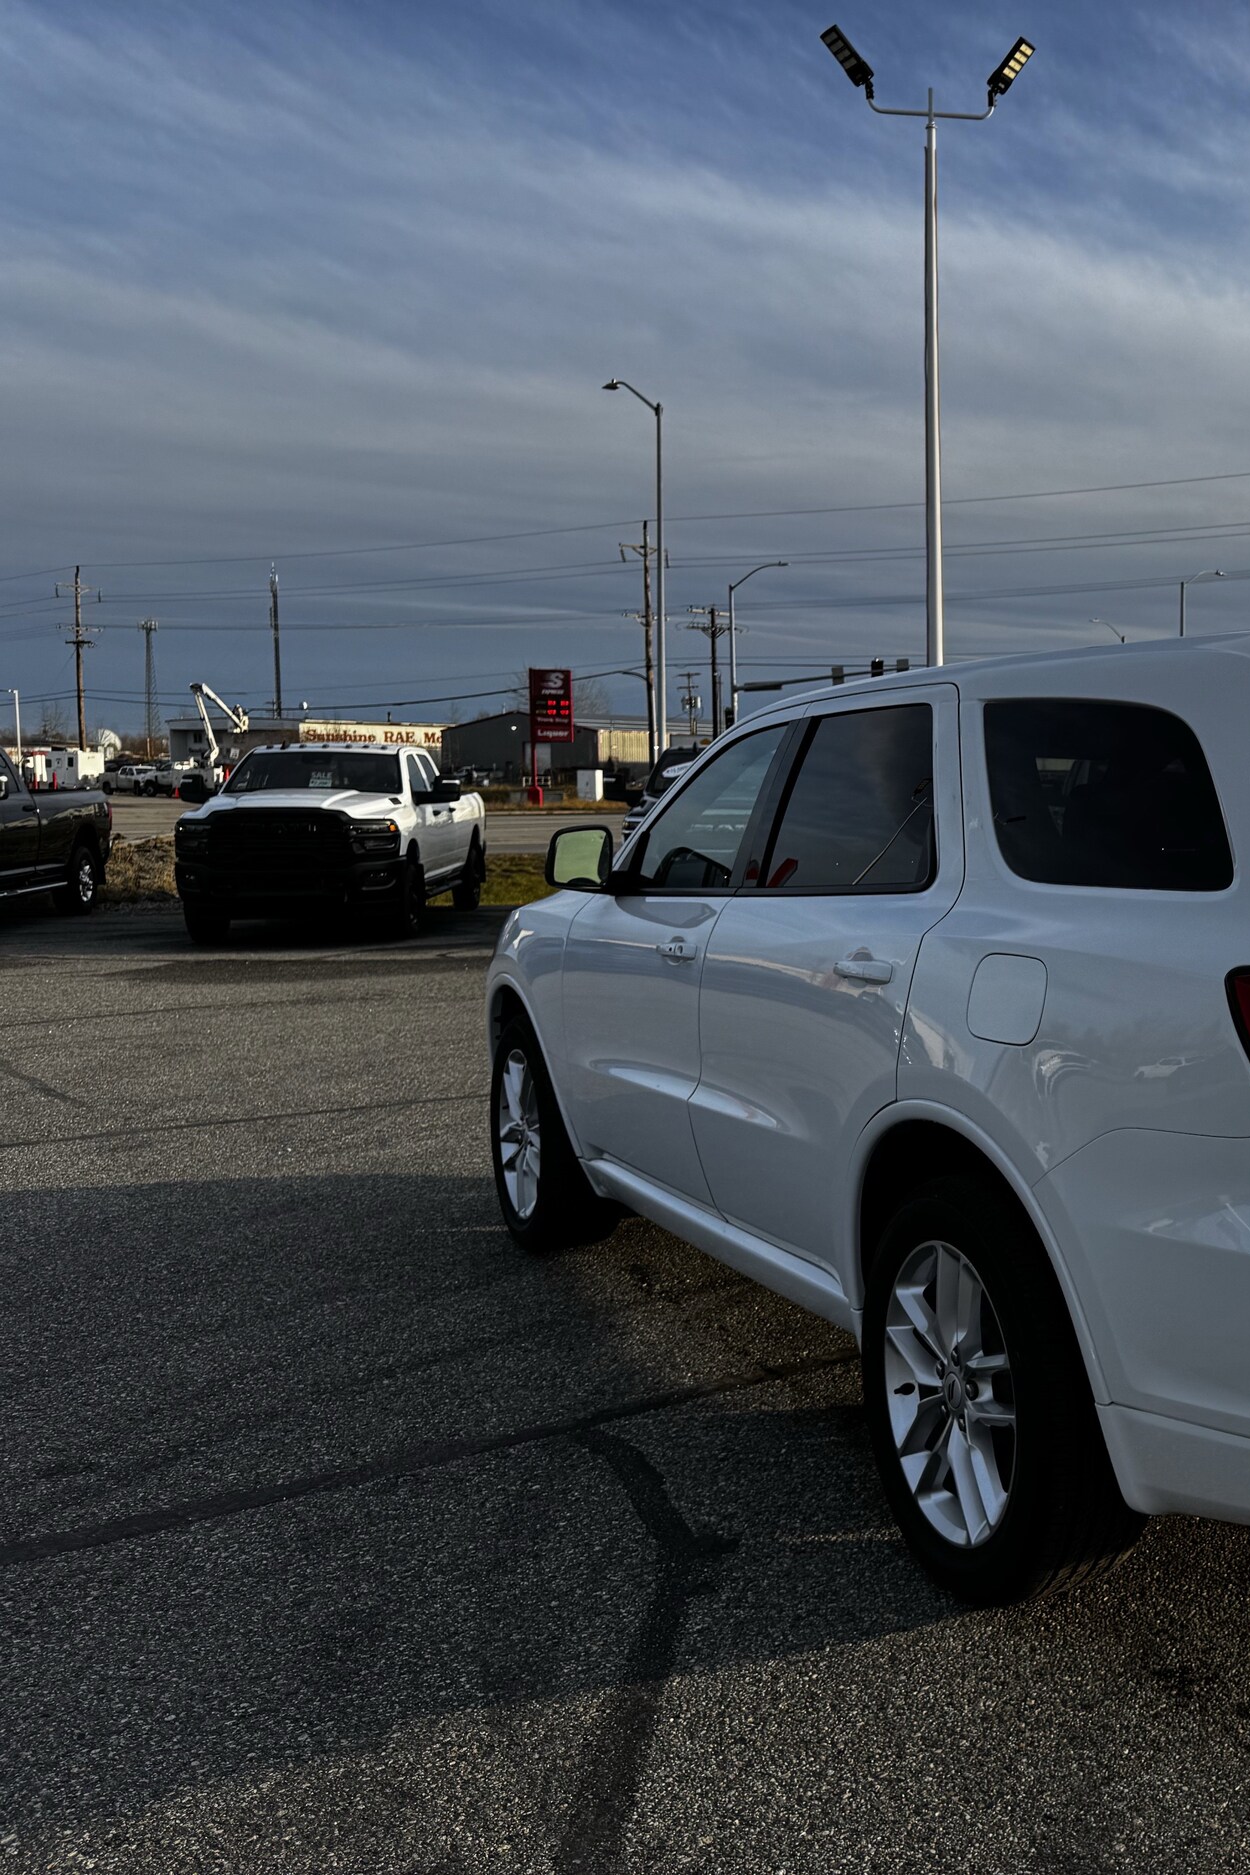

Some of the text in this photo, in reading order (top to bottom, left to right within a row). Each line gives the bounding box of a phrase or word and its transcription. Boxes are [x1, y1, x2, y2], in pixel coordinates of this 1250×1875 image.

[305, 729, 376, 743] Sunshine
[537, 729, 569, 738] Liquor
[311, 771, 333, 779] SALE
